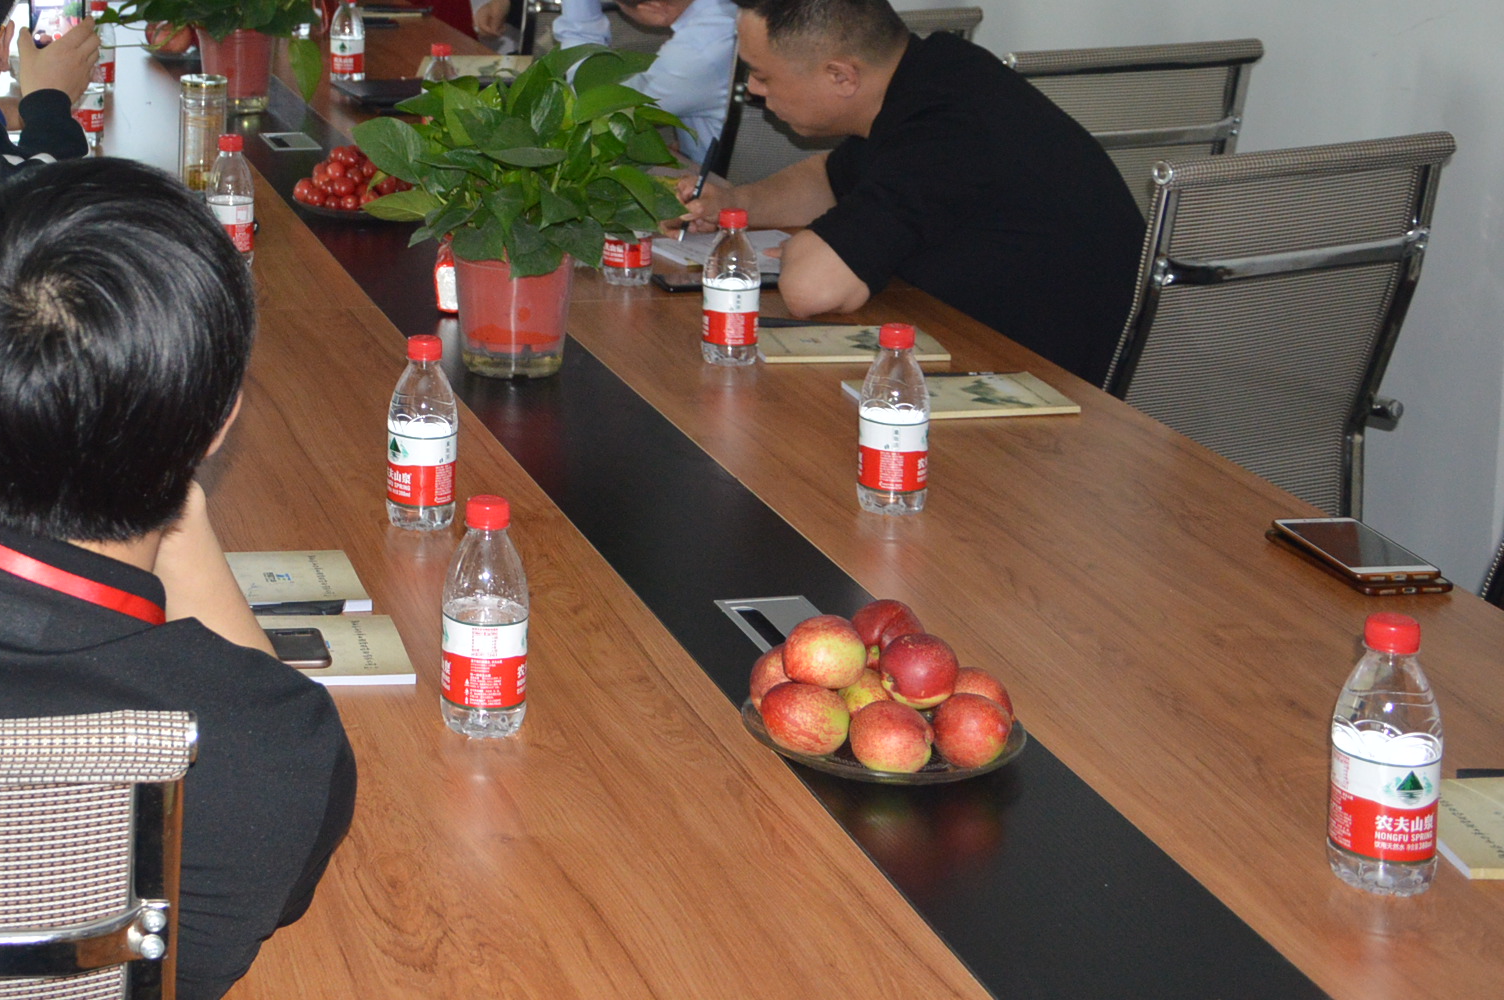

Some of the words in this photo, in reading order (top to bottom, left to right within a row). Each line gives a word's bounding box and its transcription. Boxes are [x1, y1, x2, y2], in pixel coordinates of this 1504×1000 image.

[1374, 813, 1434, 833] 农夫山泉
[1374, 831, 1409, 842] NONGFU
[1411, 831, 1433, 842] SPRING
